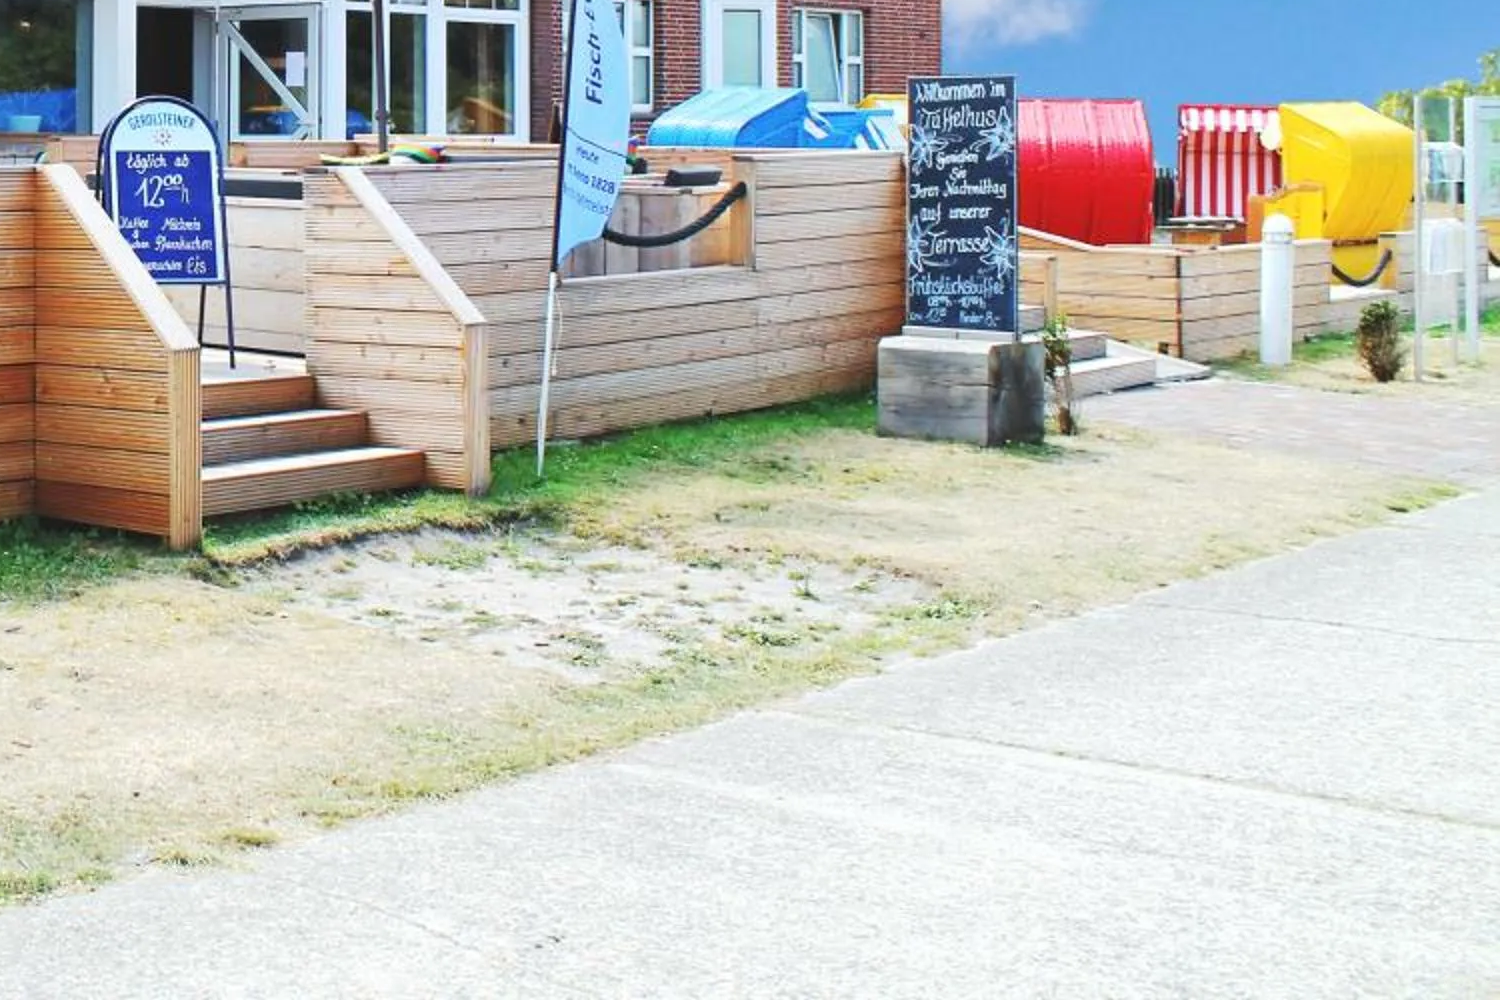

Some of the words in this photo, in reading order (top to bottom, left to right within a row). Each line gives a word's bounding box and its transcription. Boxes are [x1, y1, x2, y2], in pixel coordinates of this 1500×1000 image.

[915, 82, 987, 103] Willkommen
[989, 80, 1006, 97] im
[128, 111, 195, 131] GEROLSTEINER
[174, 154, 190, 168] ab
[949, 166, 967, 181] Sie
[942, 178, 1007, 199] Nachmittag
[919, 202, 941, 225] auf
[948, 207, 992, 219] unserer
[922, 230, 990, 257] Terrasse
